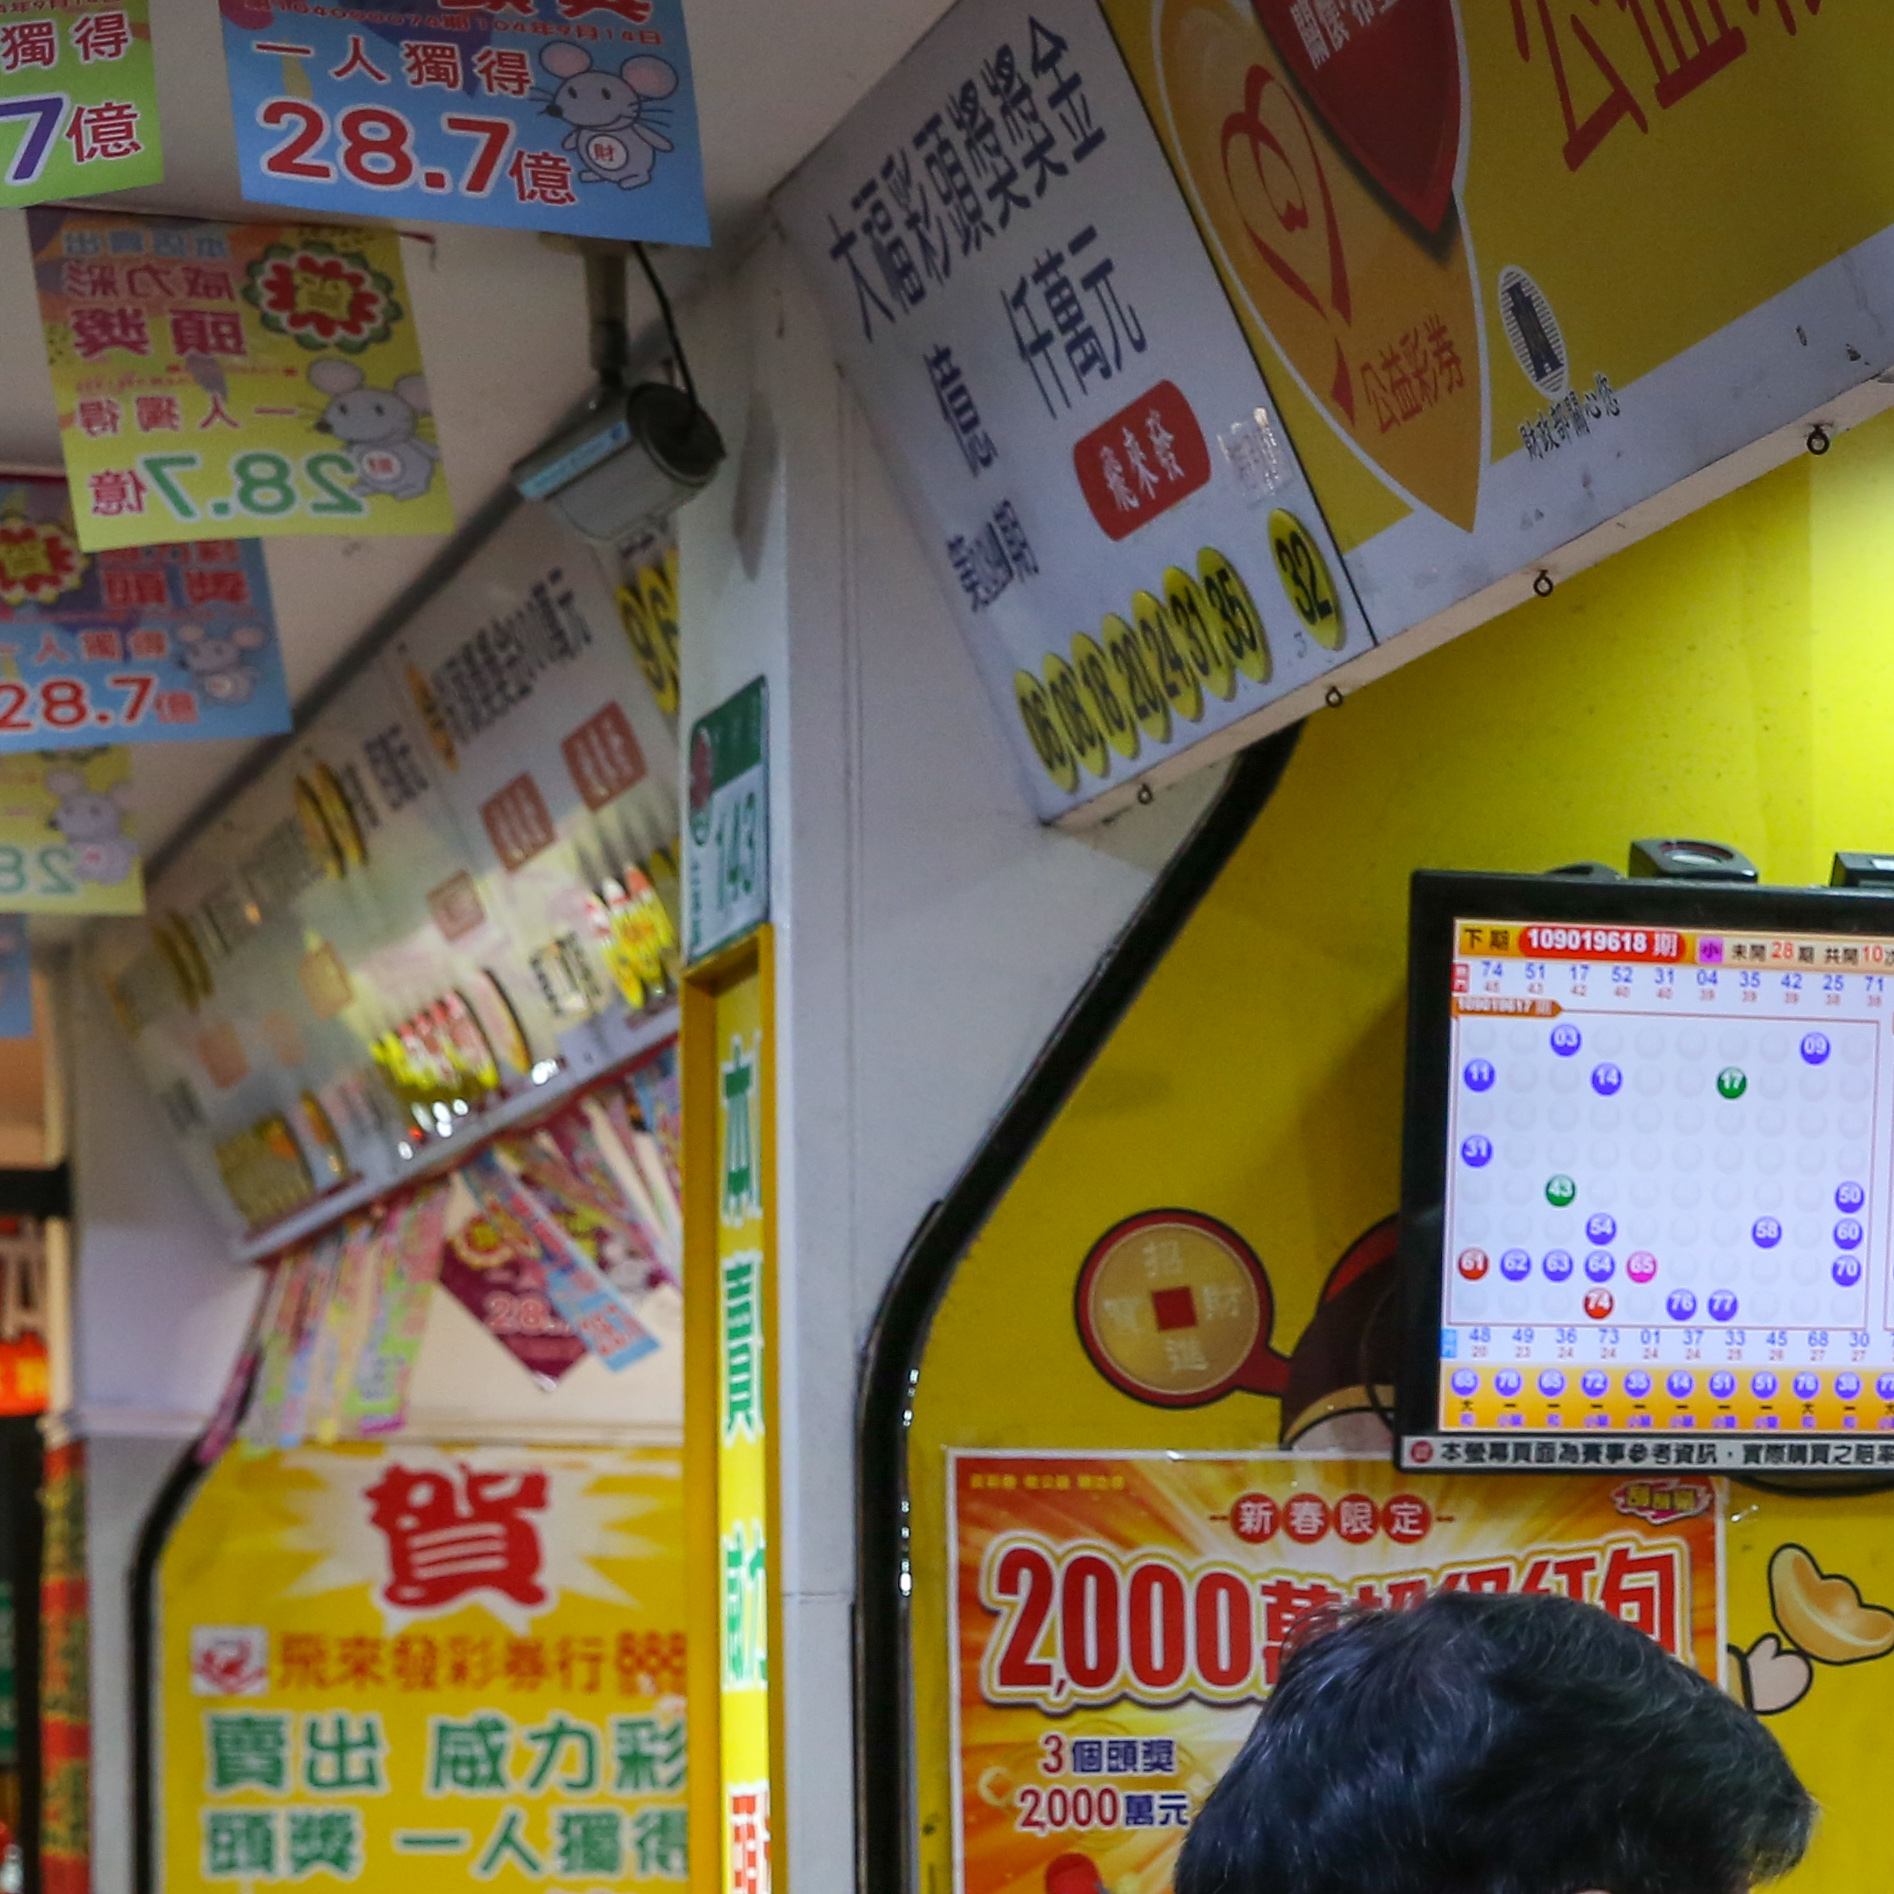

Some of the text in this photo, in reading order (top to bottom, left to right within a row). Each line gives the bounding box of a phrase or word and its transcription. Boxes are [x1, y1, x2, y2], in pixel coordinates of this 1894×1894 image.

[254, 37, 533, 97] 一人獨得
[259, 100, 577, 206] 28.7億
[827, 16, 1108, 344] 大福彩頭獎獎金
[1358, 313, 1466, 435] 公益彩券
[1098, 408, 1185, 513] 飛來發
[1203, 567, 1257, 660] 35
[1273, 530, 1334, 625] 32
[1482, 961, 1760, 988] 74 51 17 52 31 04 35
[1526, 929, 1647, 953] 109019618
[364, 1462, 550, 1610] 賀
[1236, 1497, 1429, 1537] 新春限定
[207, 1713, 688, 1794] 賣出 威力彩
[1041, 1736, 1177, 1775] 3個頭獎
[206, 1810, 689, 1876] 頭獎 一人獨得
